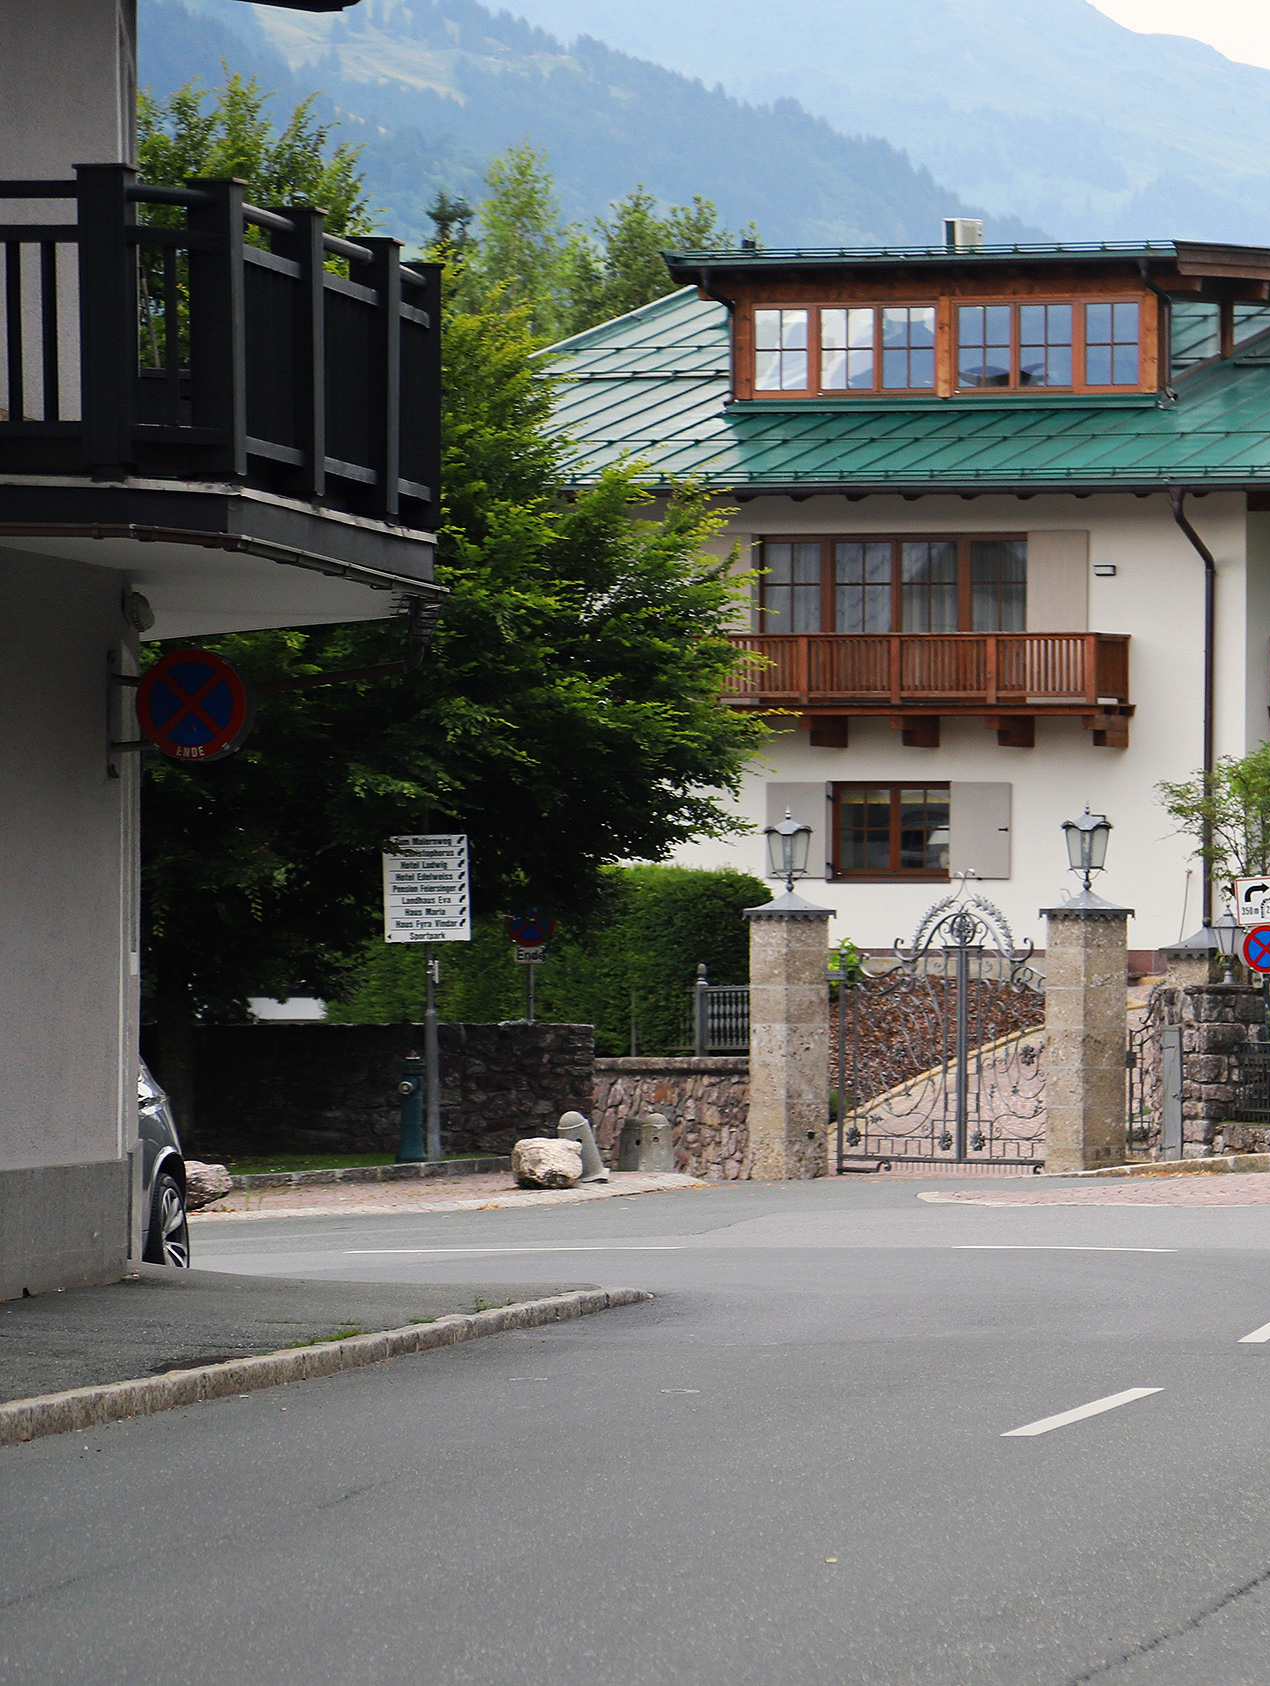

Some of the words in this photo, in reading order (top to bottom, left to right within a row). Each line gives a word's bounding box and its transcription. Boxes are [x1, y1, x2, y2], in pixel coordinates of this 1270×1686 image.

[176, 746, 205, 758] ENDE
[401, 861, 419, 869] Hotel
[422, 861, 447, 870] Ludwig
[396, 873, 414, 881] Hotel
[417, 872, 453, 880] Edelweiss
[393, 885, 418, 893] Pension
[402, 896, 435, 904] Landhaus
[438, 896, 451, 904] Eva
[405, 908, 422, 916] Haus
[425, 908, 446, 916] Maria
[416, 920, 432, 929] Fyra
[410, 931, 445, 941] Sportpark
